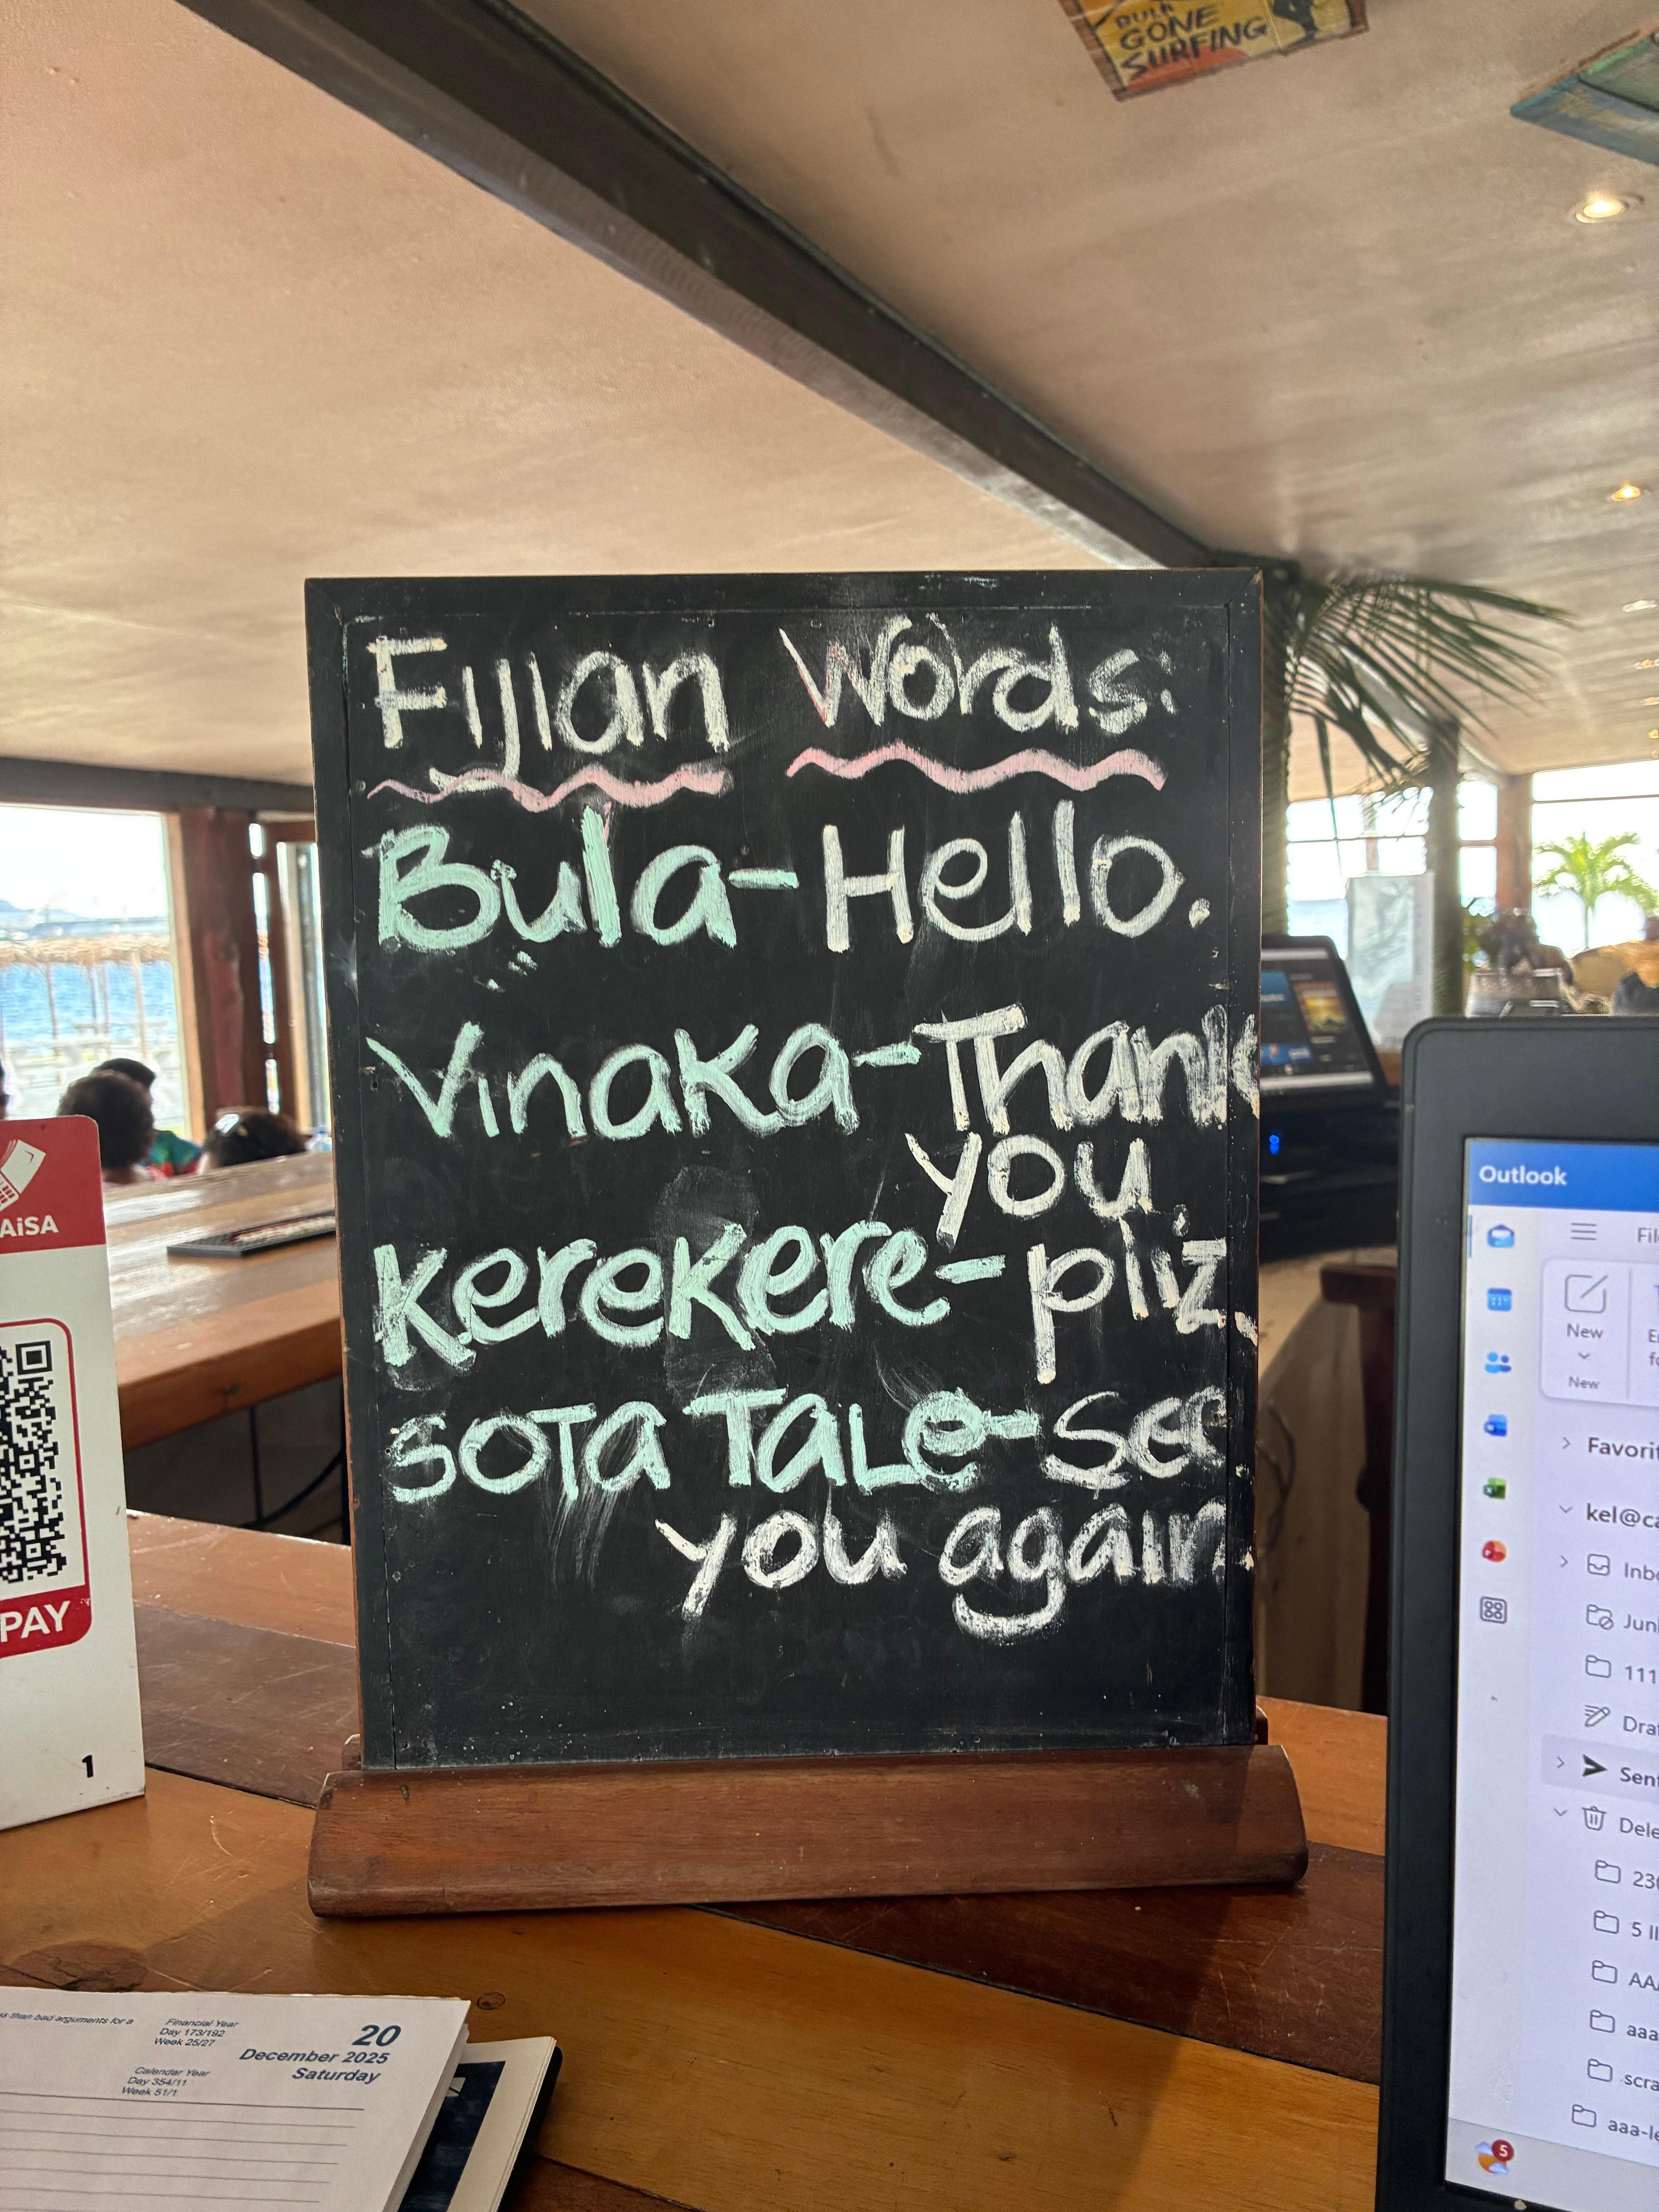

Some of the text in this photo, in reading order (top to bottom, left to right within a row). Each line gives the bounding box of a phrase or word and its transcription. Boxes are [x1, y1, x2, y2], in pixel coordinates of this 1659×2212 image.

[1120, 4, 1218, 50] GONE
[1121, 15, 1268, 81] SURFING
[1479, 1165, 1567, 1186] Outlook
[1638, 1227, 1659, 1243] Fil
[1567, 1323, 1604, 1339] New
[1568, 1376, 1599, 1389] New
[654, 1498, 1245, 1645] you again
[0, 1600, 70, 1643] PAY
[1624, 1614, 1659, 1633] Jun
[1625, 1665, 1656, 1684] 111
[1623, 1715, 1659, 1736] Dra
[81, 1754, 93, 1778] 1
[1620, 1767, 1659, 1787] Sen
[1633, 1871, 1659, 1889] 23
[1632, 1921, 1642, 1937] 5
[1628, 1972, 1659, 1991] AA
[166, 2018, 213, 2027] Financial
[160, 2028, 225, 2037] Day 173/192
[352, 2024, 402, 2047] 20
[155, 2037, 216, 2047] Week 25/27
[239, 2049, 390, 2064] December 2025
[135, 2067, 212, 2077] Calendar Year
[292, 2068, 381, 2085] Saturday
[127, 2076, 187, 2087] Day 354/11
[122, 2087, 151, 2095] Week
[1500, 2146, 1509, 2158] 5
